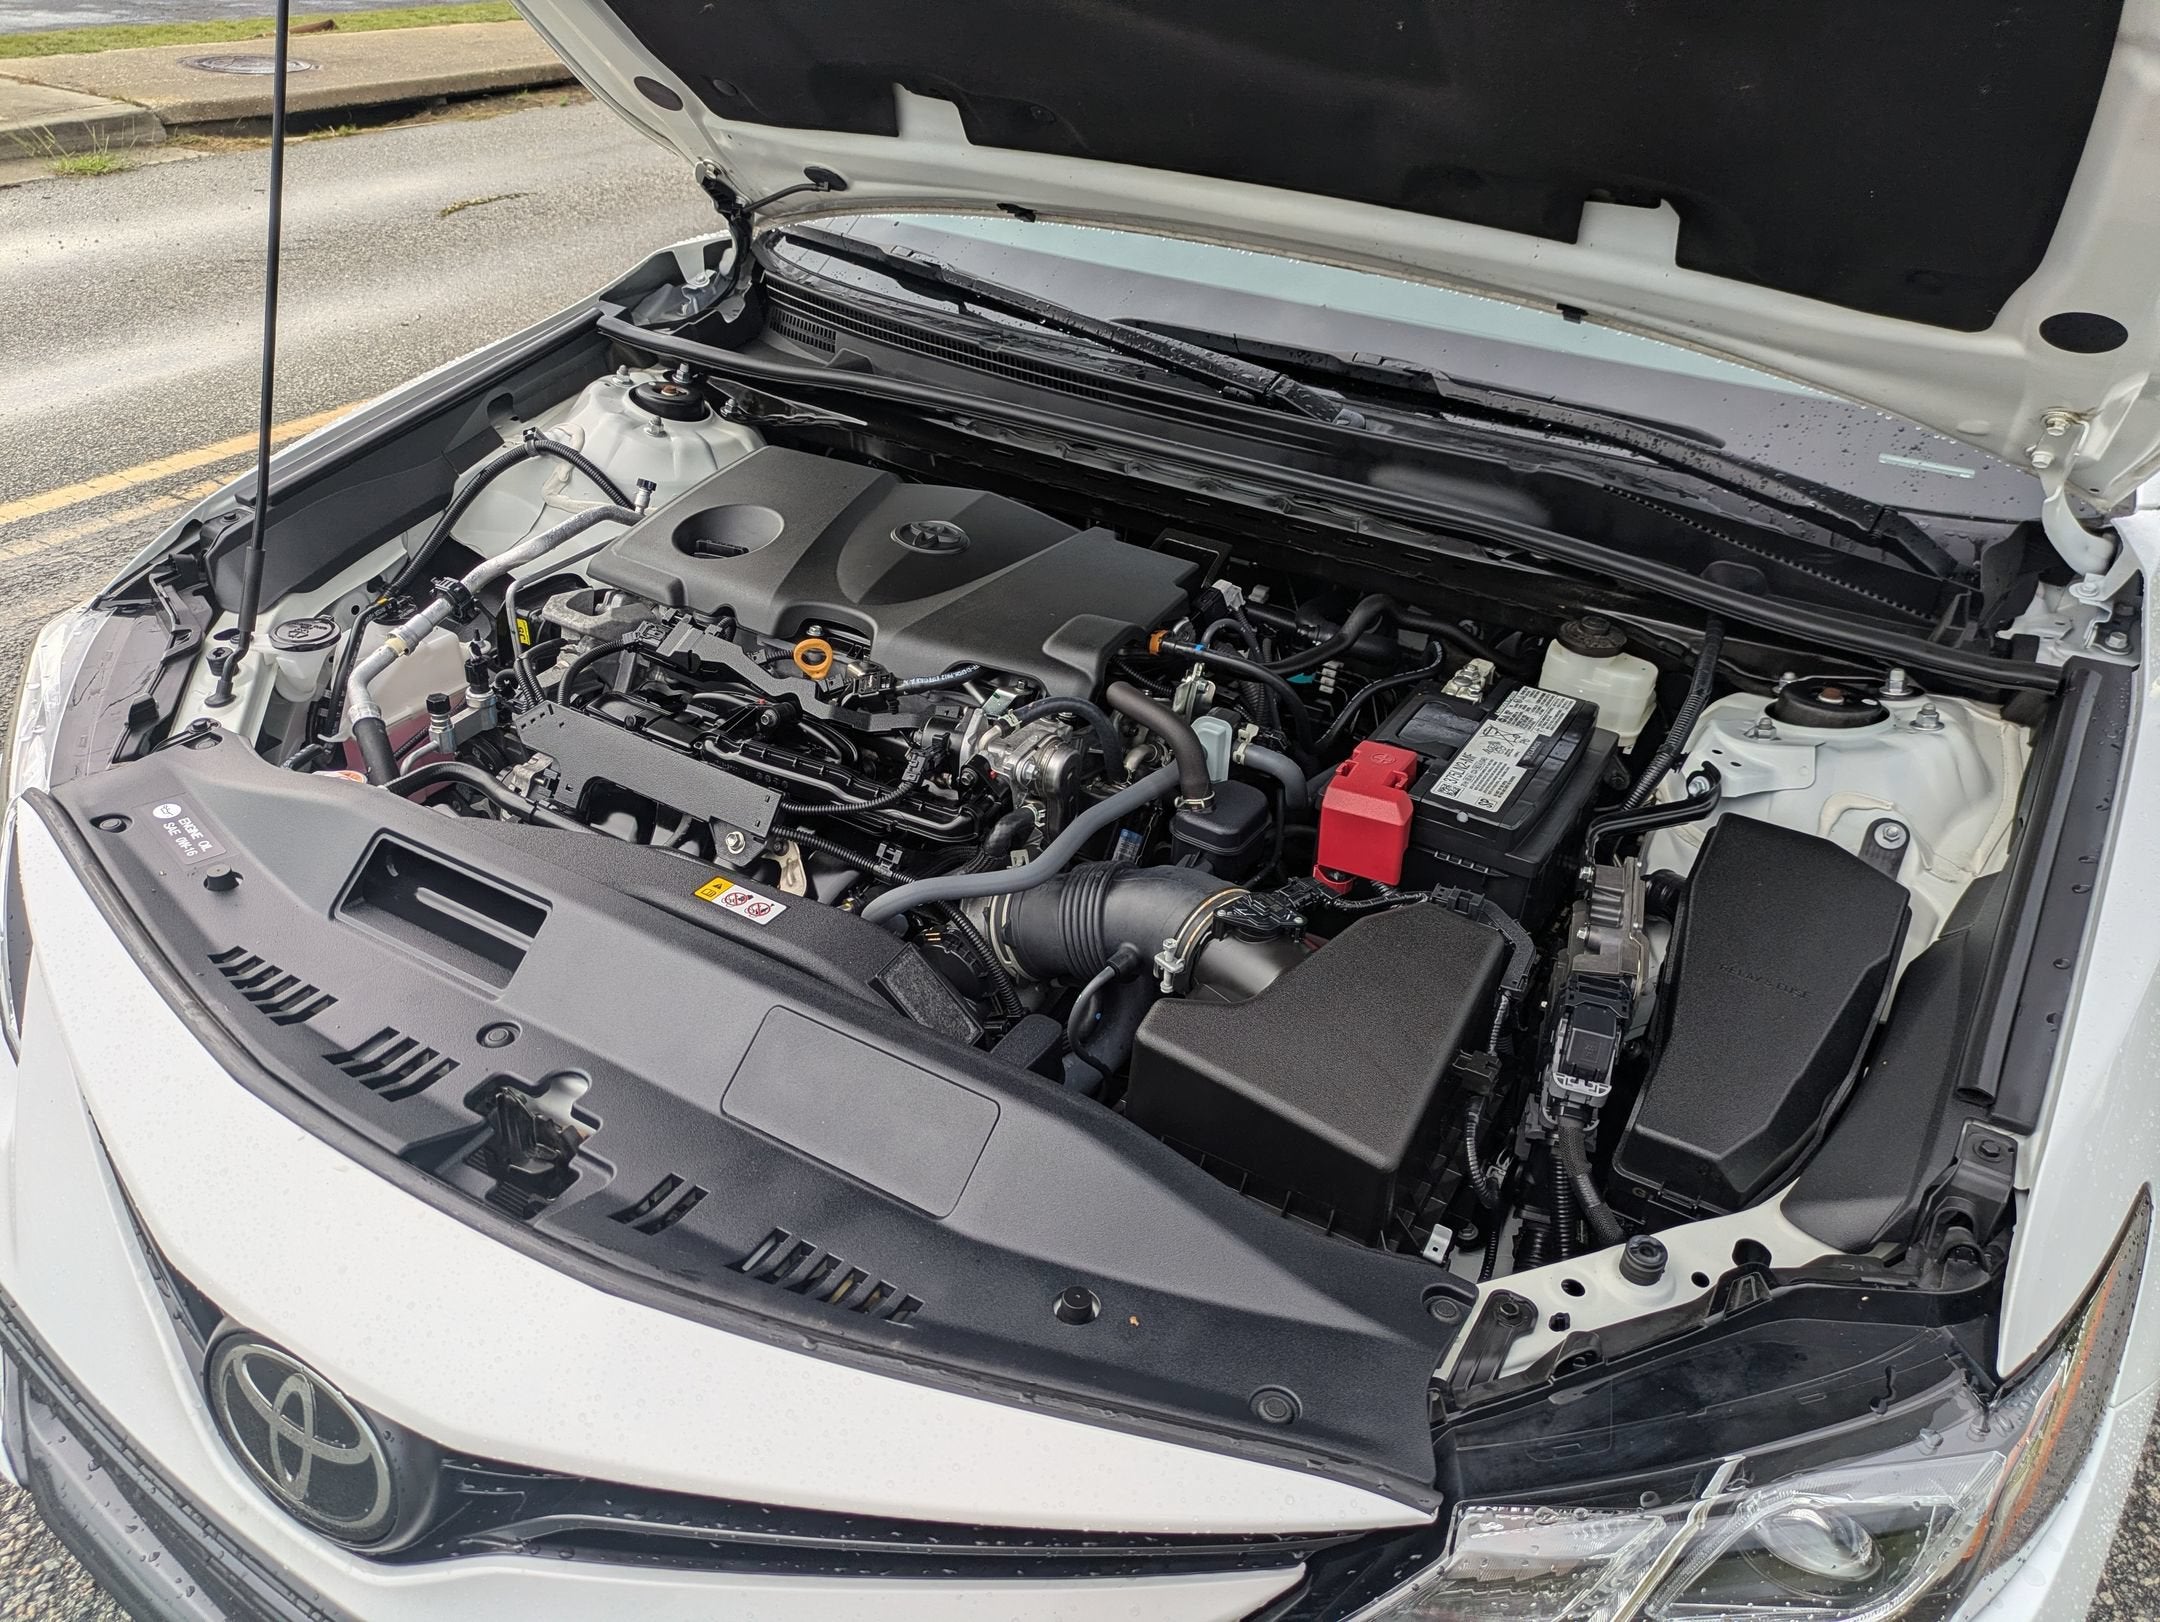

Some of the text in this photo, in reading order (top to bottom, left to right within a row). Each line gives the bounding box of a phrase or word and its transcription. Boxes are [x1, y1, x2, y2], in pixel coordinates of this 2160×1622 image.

[163, 822, 198, 857] SAE 0W-16
[178, 816, 213, 853] ENGINE OIL
